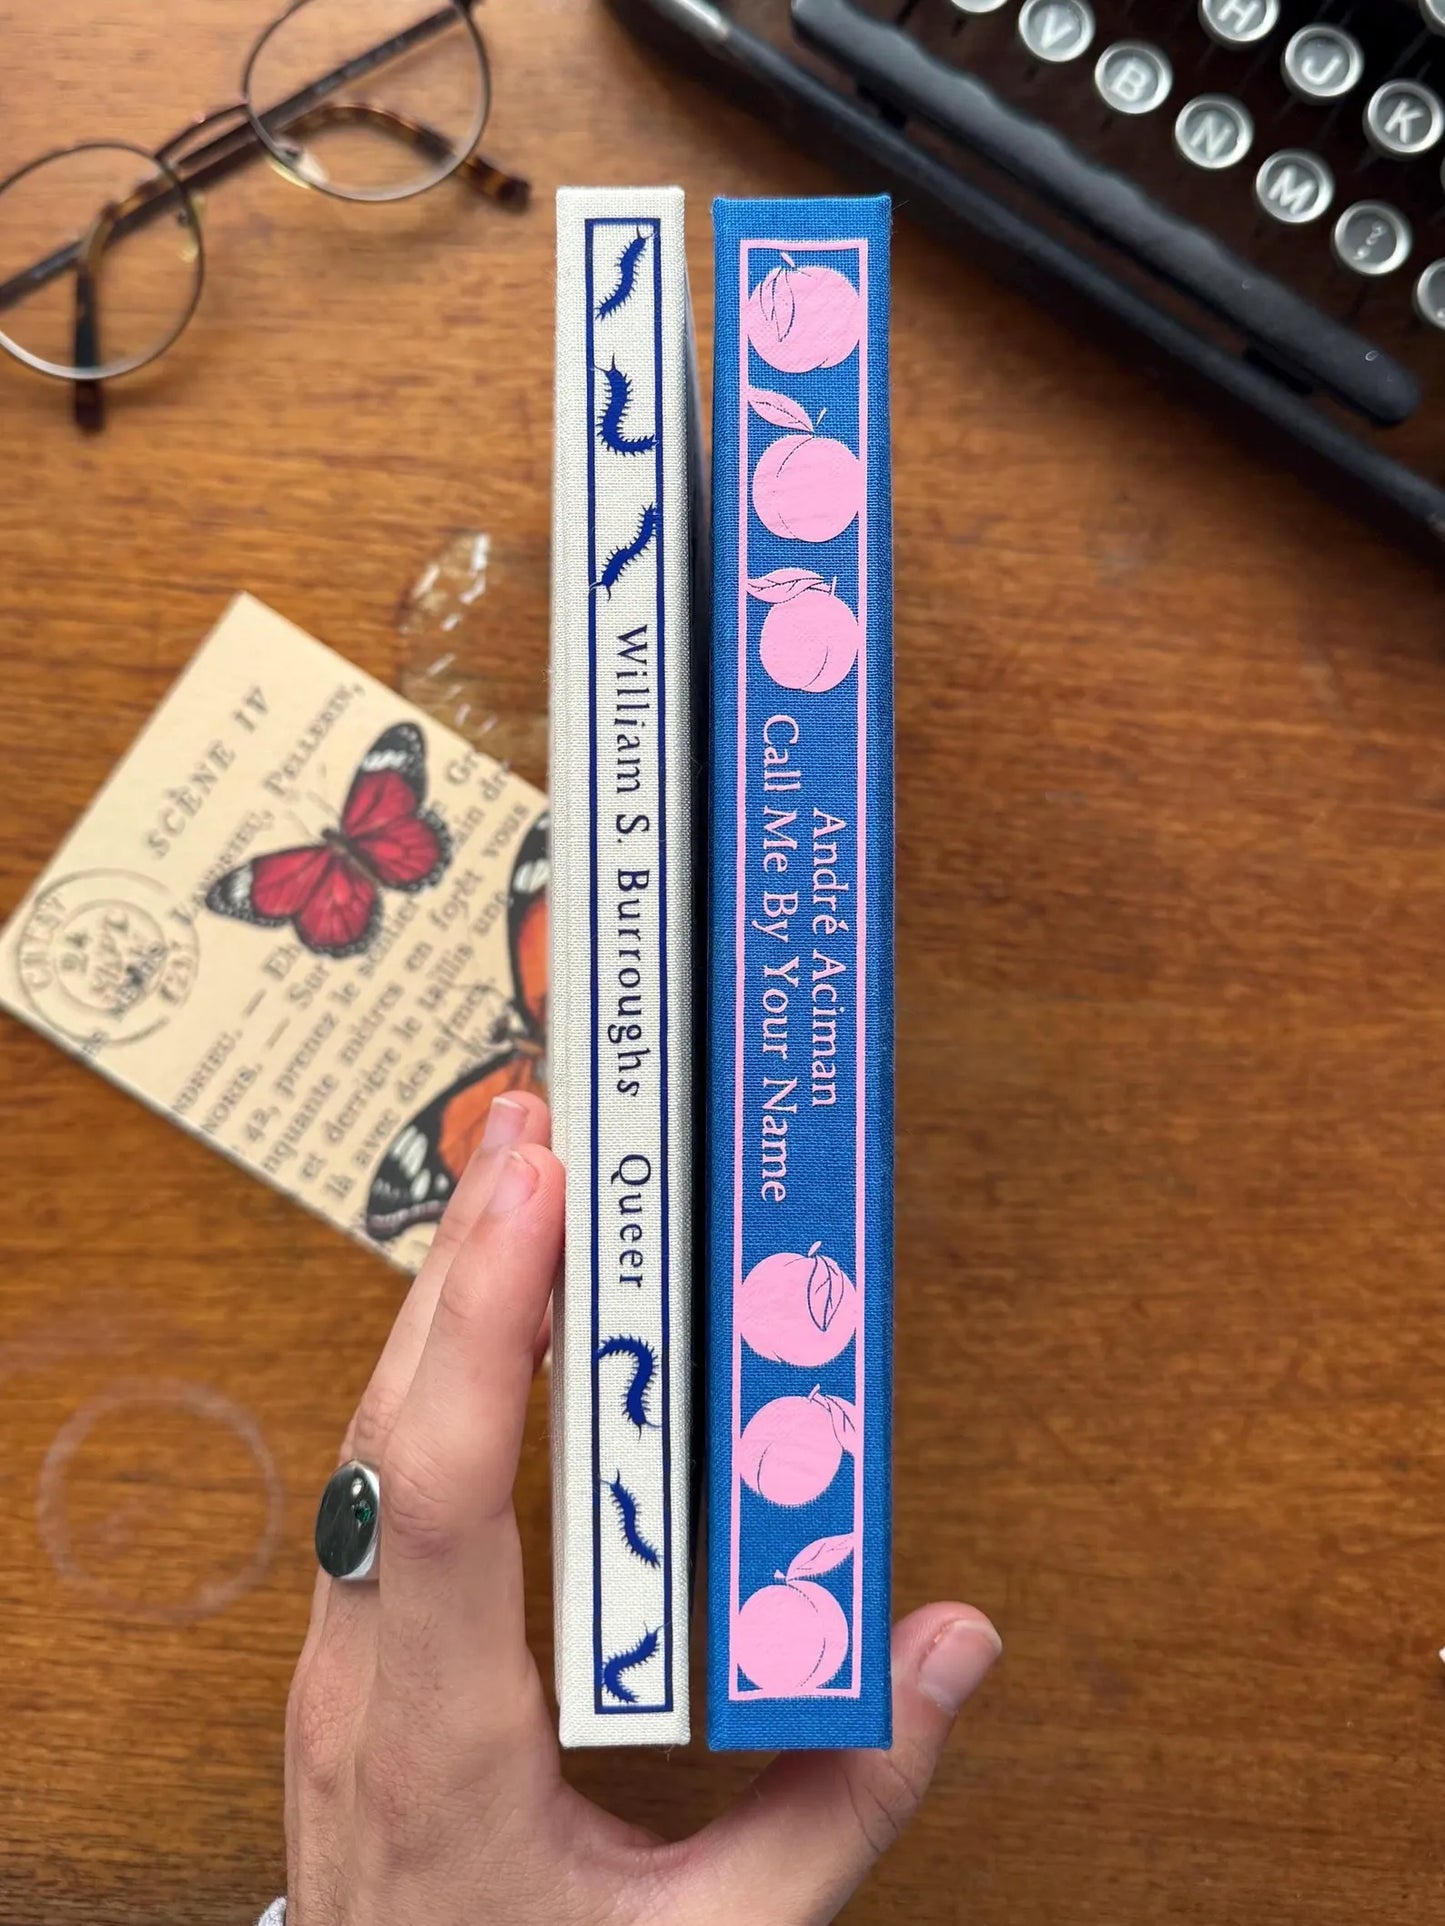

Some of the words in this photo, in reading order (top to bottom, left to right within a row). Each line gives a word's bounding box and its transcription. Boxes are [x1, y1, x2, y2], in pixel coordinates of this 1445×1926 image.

[1039, 8, 1073, 50] V
[1217, 0, 1255, 33] H
[1111, 57, 1147, 100] B
[1301, 55, 1341, 85] J
[1383, 100, 1424, 143] K
[1190, 111, 1230, 156] N
[1267, 166, 1314, 214] M
[614, 624, 650, 794] William
[763, 714, 801, 792] Call
[138, 736, 238, 861] SCÈNE
[229, 683, 275, 733] IV
[615, 814, 650, 843] S.
[763, 805, 798, 874] Me
[813, 807, 849, 935] André
[403, 939, 433, 972] en
[480, 800, 530, 862] vous
[752, 890, 799, 943] By
[607, 868, 651, 1097] Burroughs
[762, 955, 800, 1061] Your
[811, 949, 846, 1107] Aciman
[271, 1010, 343, 1100] prenez
[330, 976, 361, 1007] le
[299, 1151, 326, 1180] et
[321, 1043, 400, 1143] derrière
[392, 1012, 421, 1041] le
[352, 1107, 399, 1165] avec
[393, 1056, 433, 1102] des
[761, 1077, 798, 1202] Name
[610, 1154, 651, 1288] Queer
